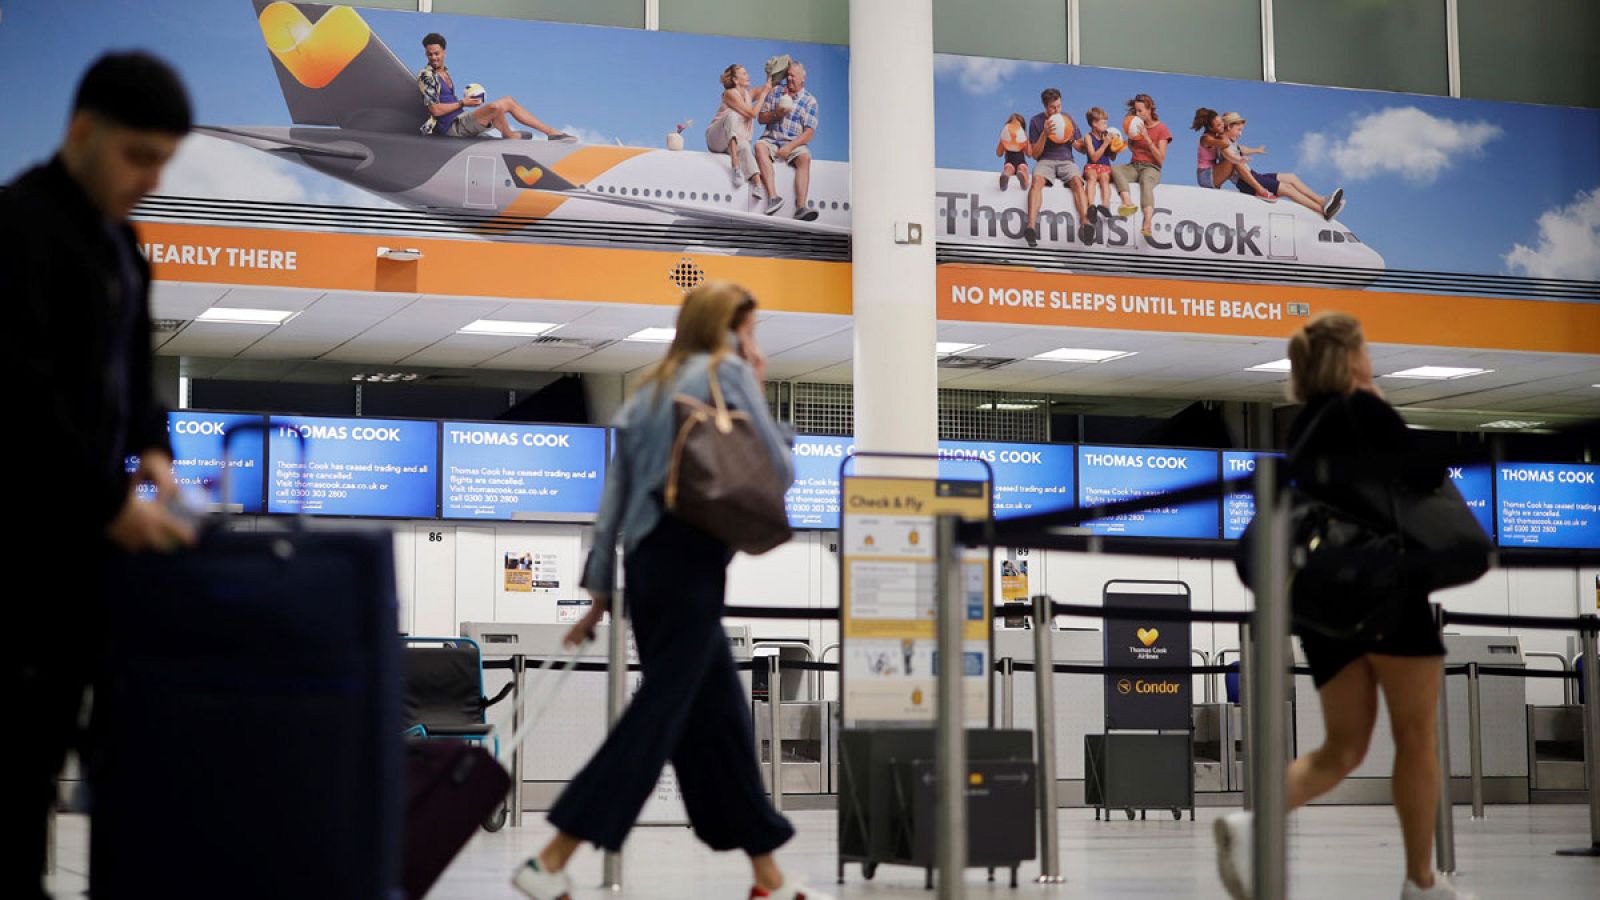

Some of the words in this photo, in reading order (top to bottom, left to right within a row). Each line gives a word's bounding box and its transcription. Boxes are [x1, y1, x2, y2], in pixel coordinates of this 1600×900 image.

[1149, 206, 1266, 257] Cook
[225, 247, 297, 270] THERE
[951, 285, 983, 305] NO
[988, 288, 1045, 308] MORE
[1049, 291, 1116, 312] SLEEPS
[1121, 295, 1177, 316] UNTIL
[1180, 298, 1216, 317] THE
[1220, 300, 1282, 321] BEACH
[175, 420, 225, 435] COOK
[351, 427, 401, 442] COOK
[450, 430, 518, 446] THOMAS
[522, 433, 570, 448] COOK
[791, 443, 842, 457] HOMAS
[999, 451, 1042, 464] COOK
[1084, 454, 1144, 467] THOMAS
[1147, 456, 1188, 469] COOK
[309, 461, 329, 470] Cook
[330, 462, 343, 471] has
[345, 463, 372, 472] ceased
[374, 464, 401, 474] trading
[403, 465, 417, 473] and
[419, 465, 428, 473] all
[1228, 459, 1256, 472] THO
[449, 466, 480, 475] Thomas
[481, 467, 501, 476] Cook
[502, 468, 515, 476] has
[516, 469, 543, 477] ceased
[544, 470, 570, 479] trading
[588, 471, 597, 479] all
[1501, 468, 1554, 482] THOMAS
[1558, 471, 1595, 484] COOK
[275, 480, 292, 488] Visit
[807, 478, 825, 486] Cook
[275, 488, 289, 497] call
[311, 490, 326, 498] 303
[328, 490, 347, 498] 2800
[449, 485, 466, 493] Visit
[1020, 486, 1044, 495] trading
[1085, 487, 1111, 495] Thomas
[1111, 487, 1129, 496] Cook
[449, 494, 462, 502] call
[849, 495, 889, 509] Check
[1503, 500, 1526, 509] Thomas
[1526, 501, 1542, 509] Cook
[1543, 502, 1553, 510] has
[1576, 503, 1597, 512] trading
[1503, 517, 1516, 525] Visit
[1503, 525, 1513, 533] call
[428, 531, 442, 542] 86
[1129, 646, 1152, 654] Thomas
[1152, 646, 1167, 654] Cook
[1137, 652, 1160, 660] Airlines
[1135, 680, 1180, 694] Condor
